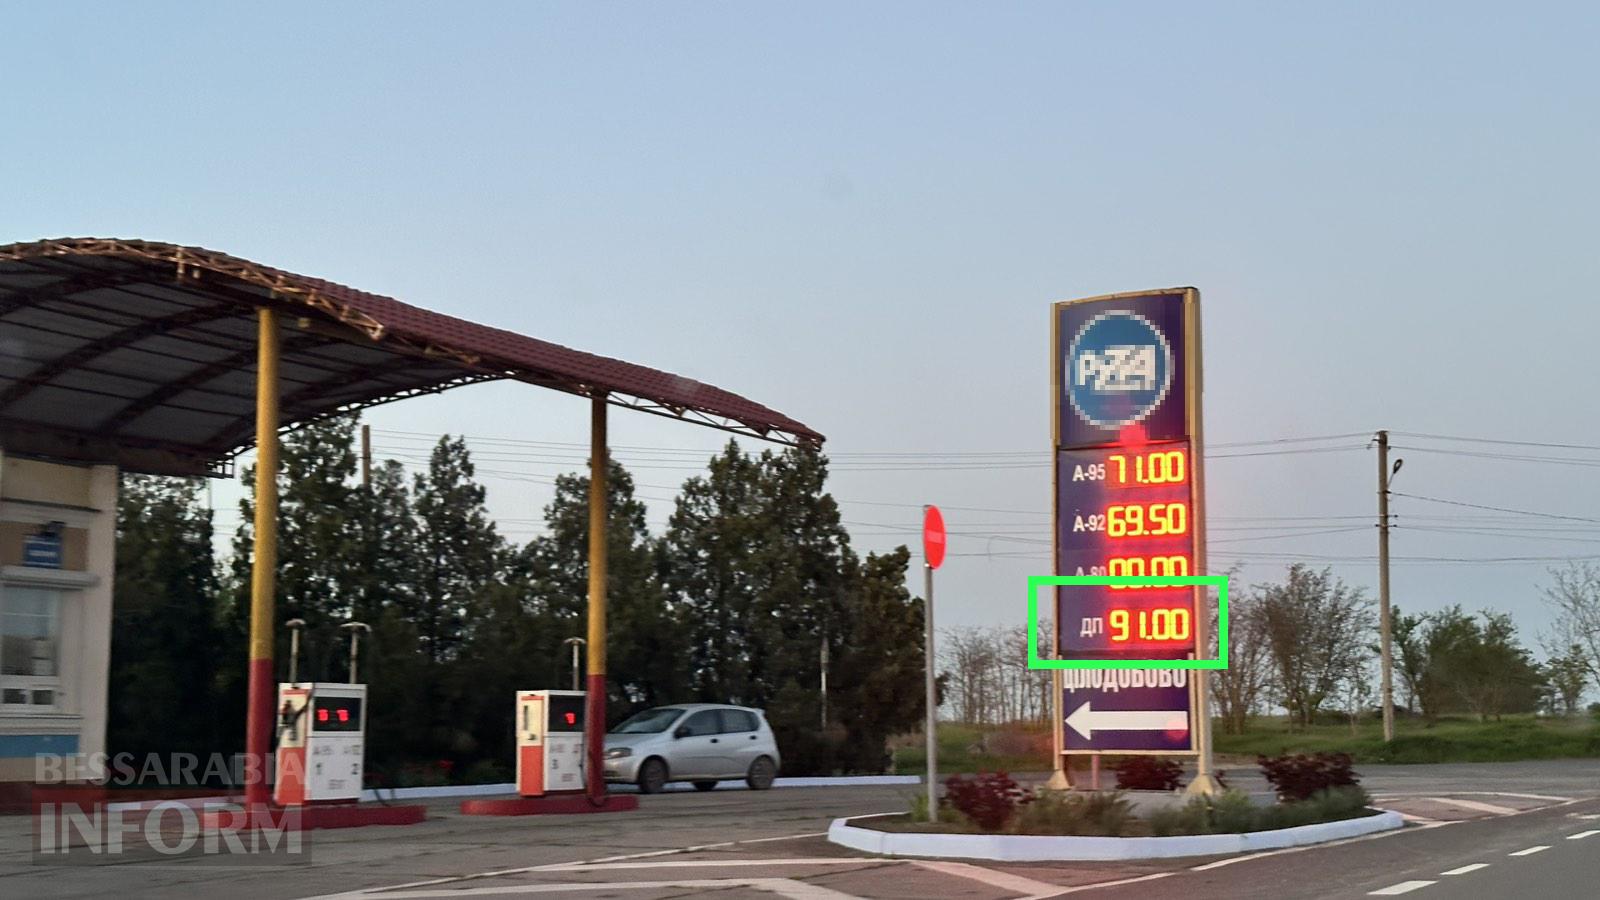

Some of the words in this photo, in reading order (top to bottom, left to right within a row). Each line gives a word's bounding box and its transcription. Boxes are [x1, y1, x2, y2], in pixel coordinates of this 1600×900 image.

[1073, 463, 1105, 482] А-95
[1109, 451, 1184, 484] 71.00
[1073, 514, 1106, 533] А-92
[1107, 502, 1186, 538] 69.50
[1079, 617, 1103, 637] ДП
[1109, 608, 1189, 641] 91.00
